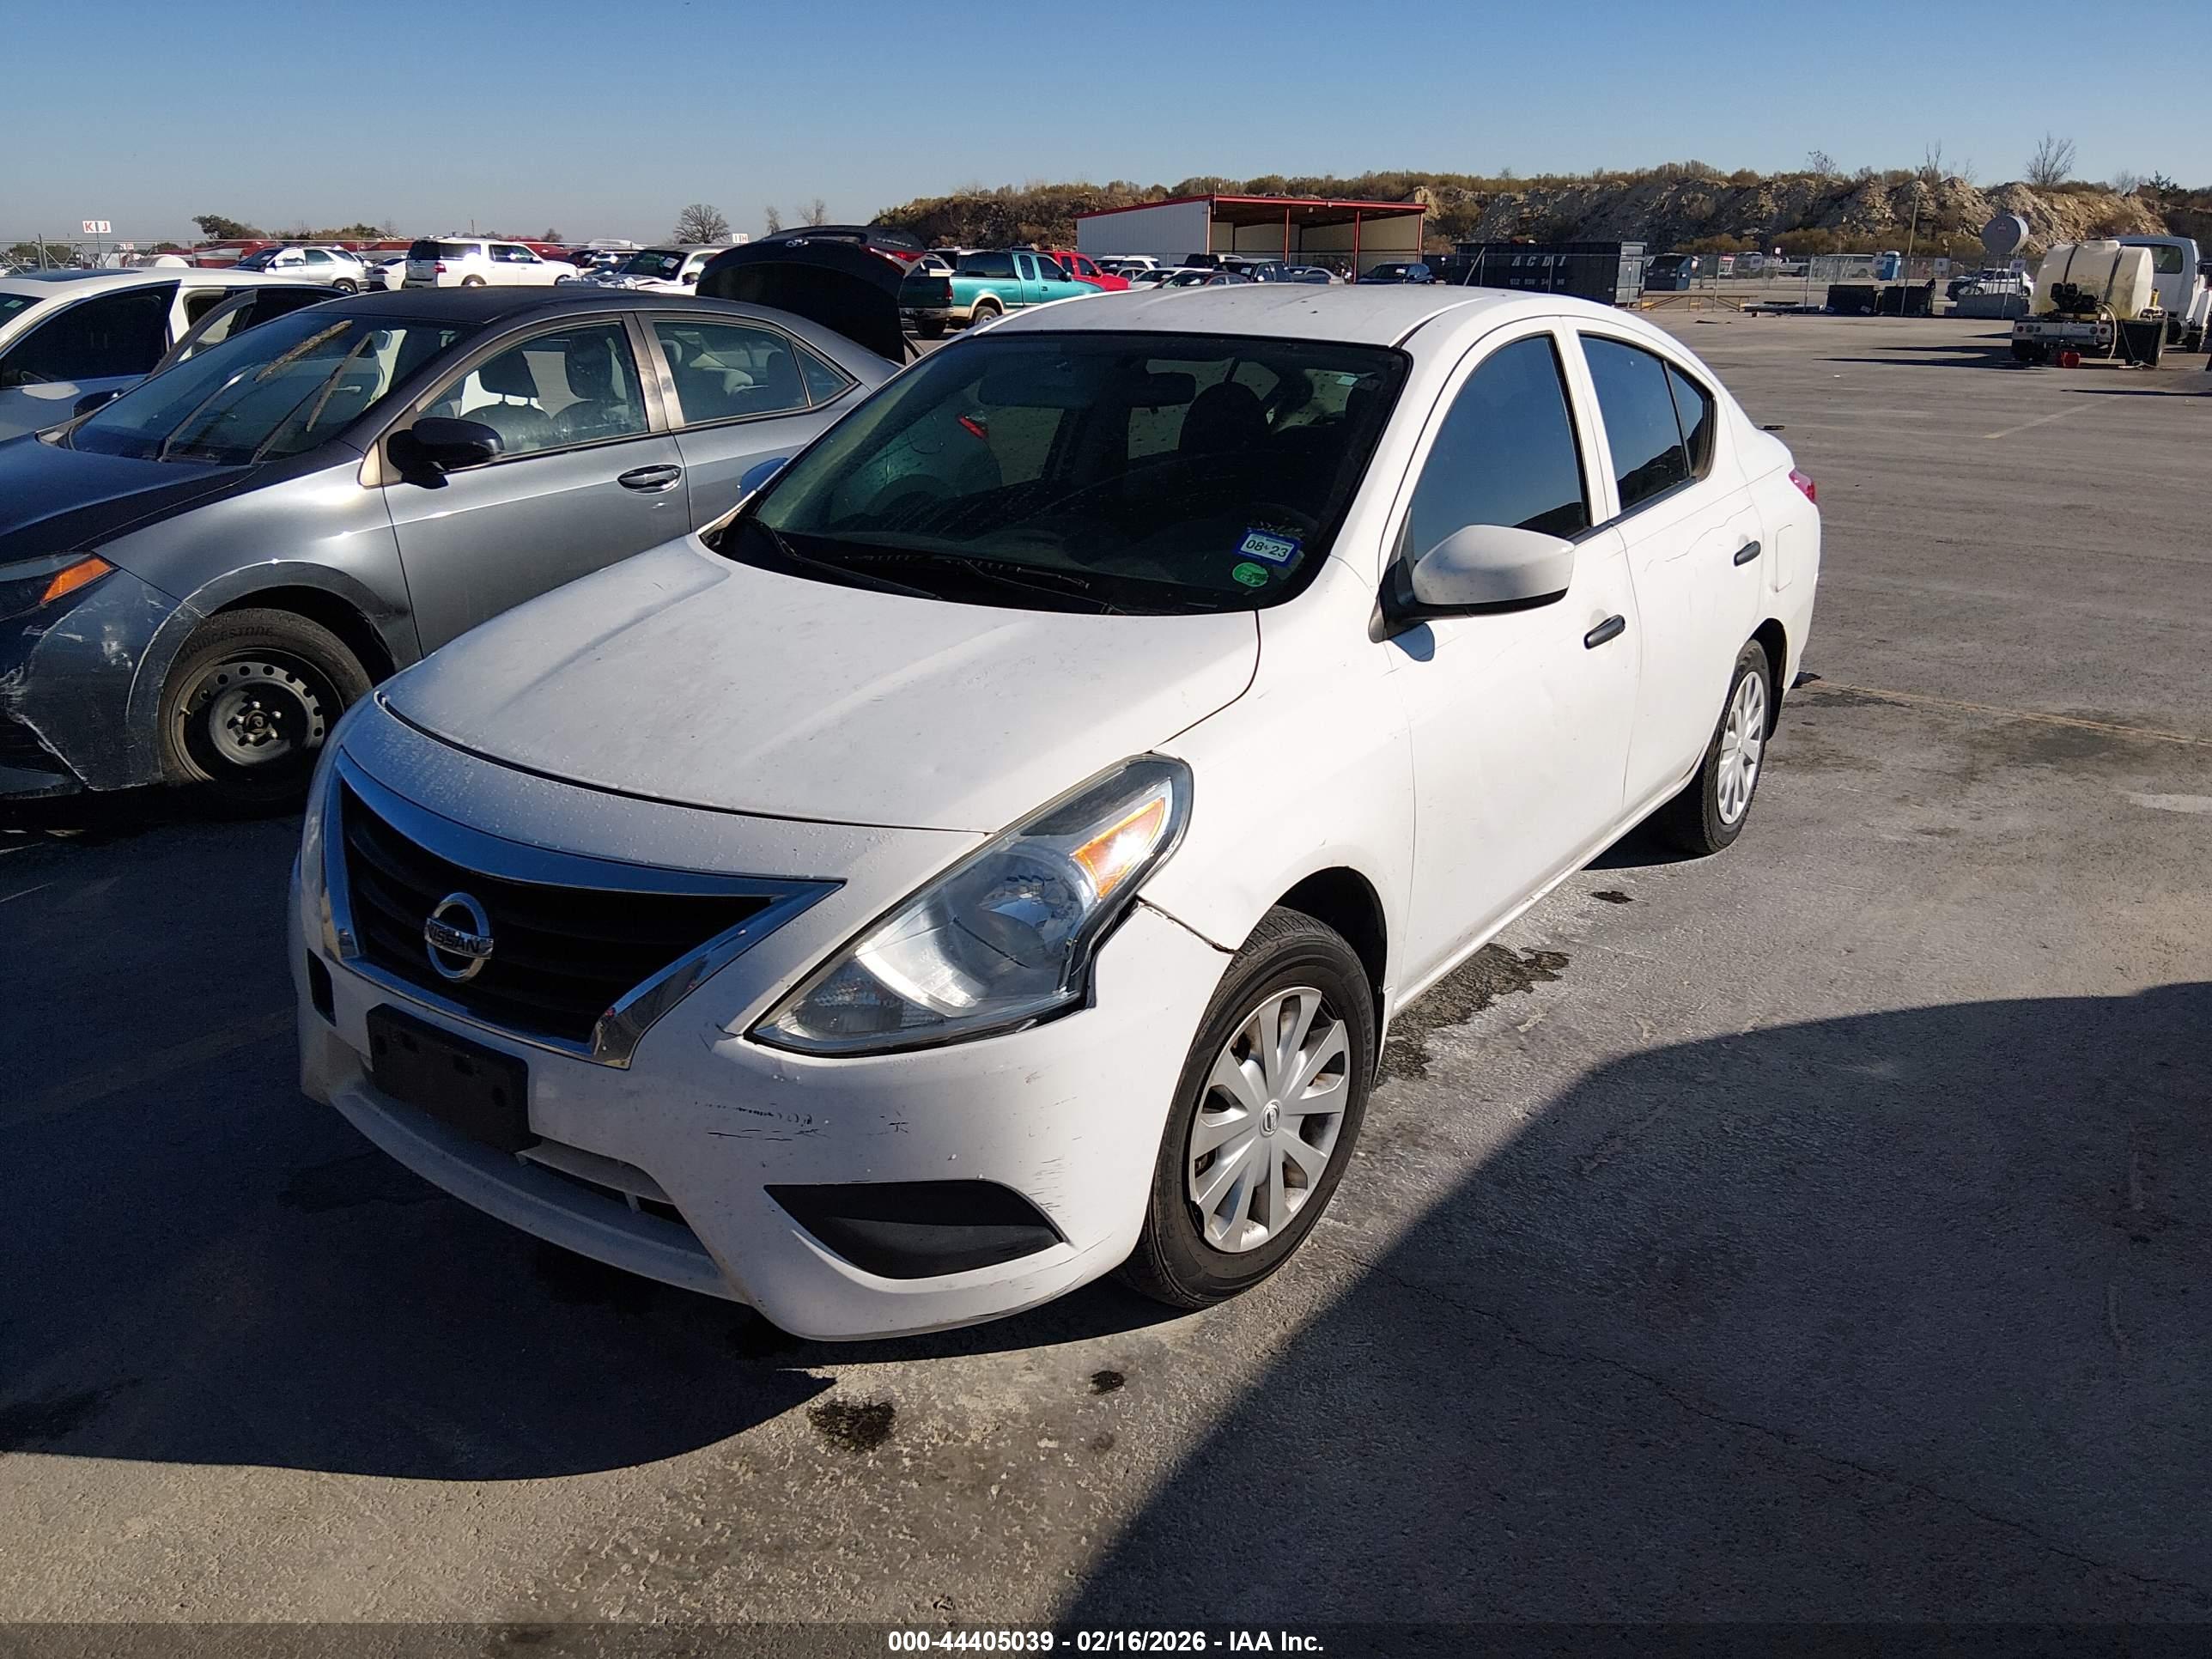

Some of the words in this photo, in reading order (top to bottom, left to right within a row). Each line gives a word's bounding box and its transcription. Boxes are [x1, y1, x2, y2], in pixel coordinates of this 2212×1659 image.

[1246, 539, 1265, 551] 08
[1268, 544, 1289, 558] 23
[428, 924, 482, 953] NISSAN
